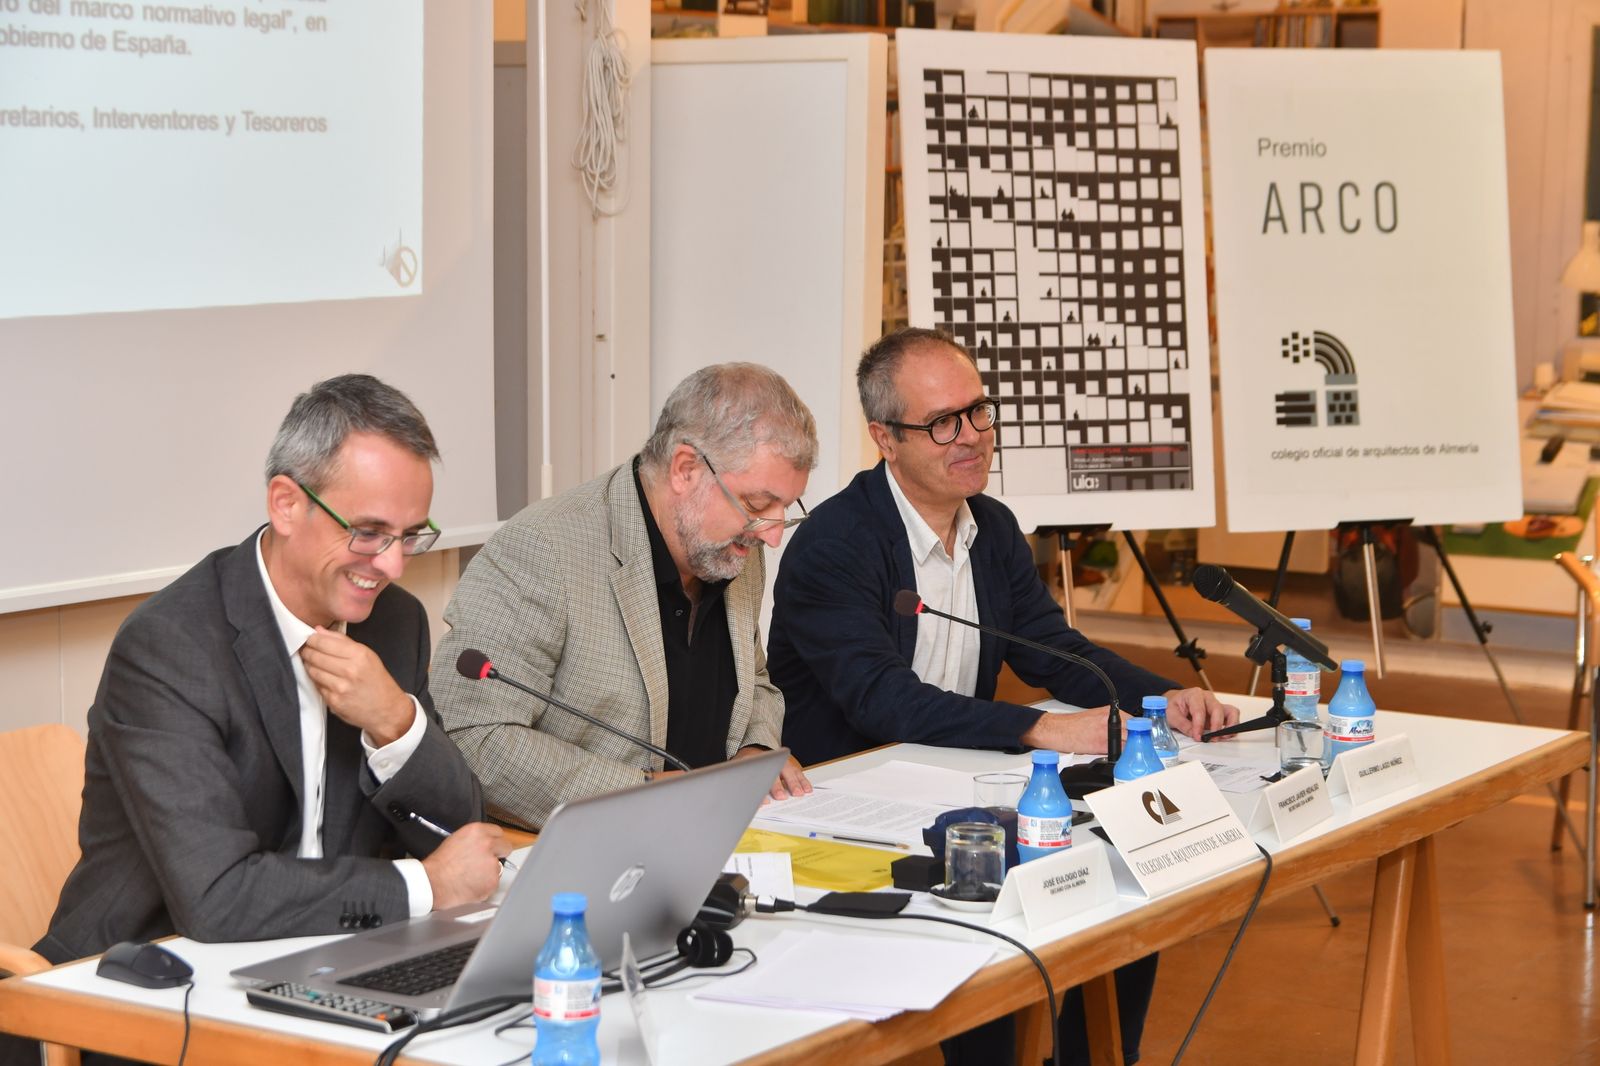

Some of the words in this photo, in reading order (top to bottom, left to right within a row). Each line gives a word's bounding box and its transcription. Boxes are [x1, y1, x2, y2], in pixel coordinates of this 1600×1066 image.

[70, 0, 134, 20] marco
[142, 5, 236, 27] normativo
[305, 15, 328, 32] en
[80, 28, 107, 50] de
[112, 30, 192, 58] España.
[93, 106, 220, 131] Interventores
[225, 114, 236, 136] y
[241, 110, 328, 133] Tesoreros
[1258, 137, 1328, 158] Premio
[1262, 181, 1399, 235] ARCO
[1271, 448, 1310, 462] colegio
[1312, 446, 1344, 459] oficial
[1346, 446, 1360, 458] de
[1362, 445, 1420, 460] arquitectos
[1423, 444, 1436, 456] de
[1136, 855, 1166, 877] COLEGIO
[1170, 839, 1212, 863] ARQUITECTOS
